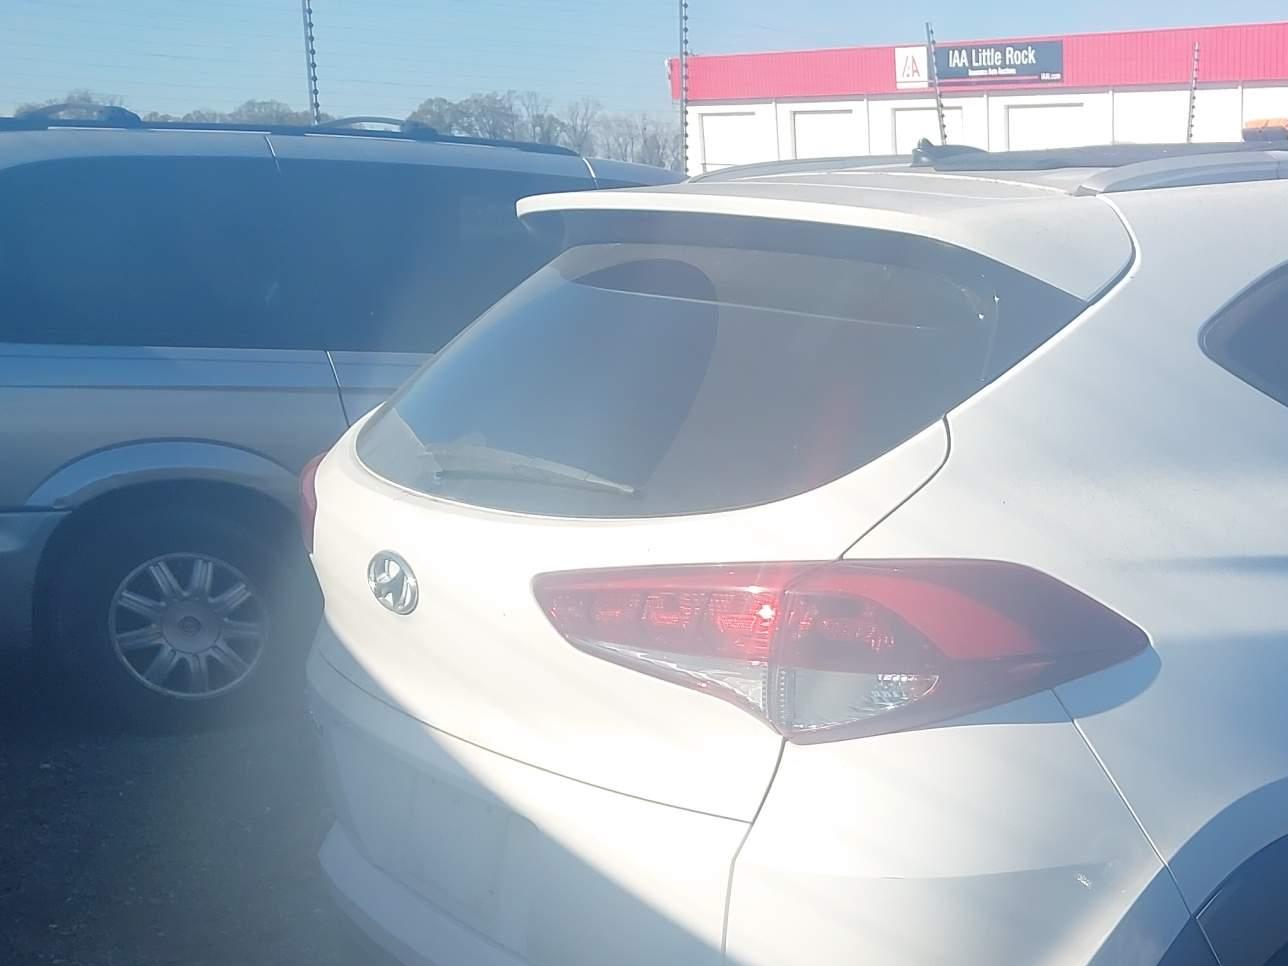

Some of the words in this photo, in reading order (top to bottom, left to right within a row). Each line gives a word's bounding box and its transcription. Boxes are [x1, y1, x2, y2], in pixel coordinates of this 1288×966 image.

[948, 49, 969, 68] IAA
[971, 47, 1002, 67] Little
[1005, 45, 1036, 65] Rock
